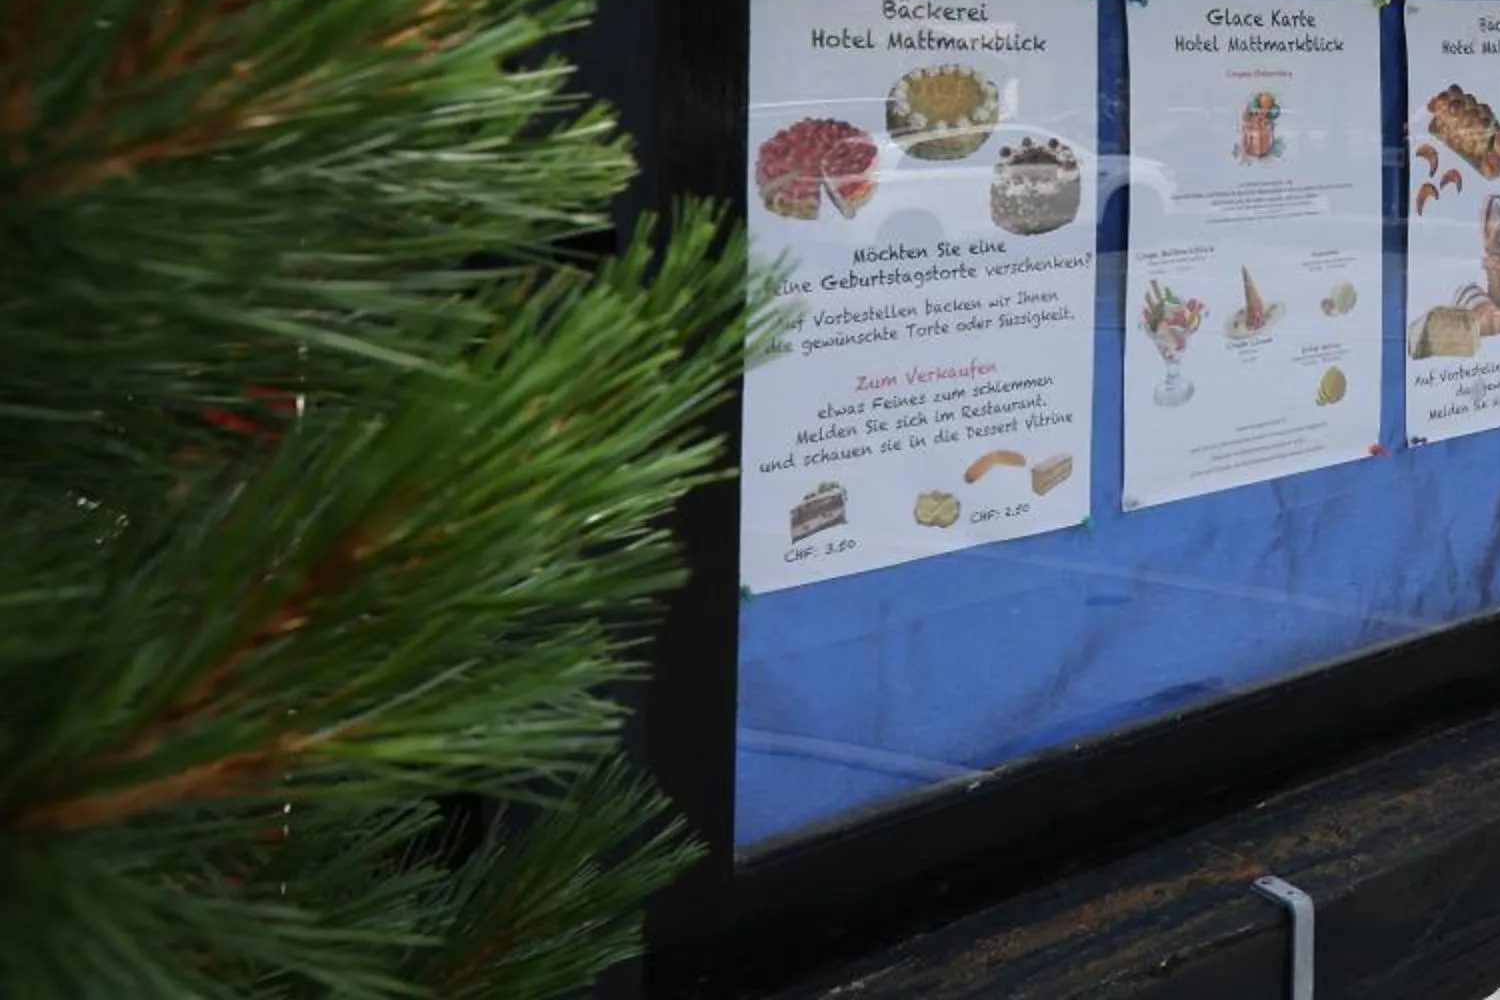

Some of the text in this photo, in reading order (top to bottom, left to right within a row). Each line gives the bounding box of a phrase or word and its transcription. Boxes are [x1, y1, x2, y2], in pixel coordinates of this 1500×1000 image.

[1206, 7, 1317, 29] Glace Karte
[811, 29, 1048, 52] Hotel Mattmarkblick
[1174, 33, 1345, 53] Hotel Mattmarkblick
[853, 240, 1007, 264] Möchten Sie eine
[820, 263, 977, 290] Geburtstagstorte
[985, 252, 1092, 277] verschenken?
[813, 303, 918, 327] Vorbestellen
[925, 298, 982, 316] backen
[988, 296, 1011, 309] wir
[1016, 291, 1059, 306] Ihnen
[800, 326, 898, 356] gewünschte
[906, 320, 950, 339] Torte
[955, 317, 992, 332] oder
[855, 358, 998, 391] Zum Verkaufen
[817, 402, 866, 420] etwas
[871, 393, 927, 411] Feines
[932, 390, 966, 404] zum
[759, 453, 796, 473] und
[803, 444, 873, 467] schauen
[908, 434, 927, 448] in
[933, 428, 961, 445] die
[966, 416, 1019, 438] Dessert
[796, 423, 858, 446] Melden
[864, 418, 889, 435] Sie
[896, 411, 928, 430] sich
[935, 410, 955, 424] im
